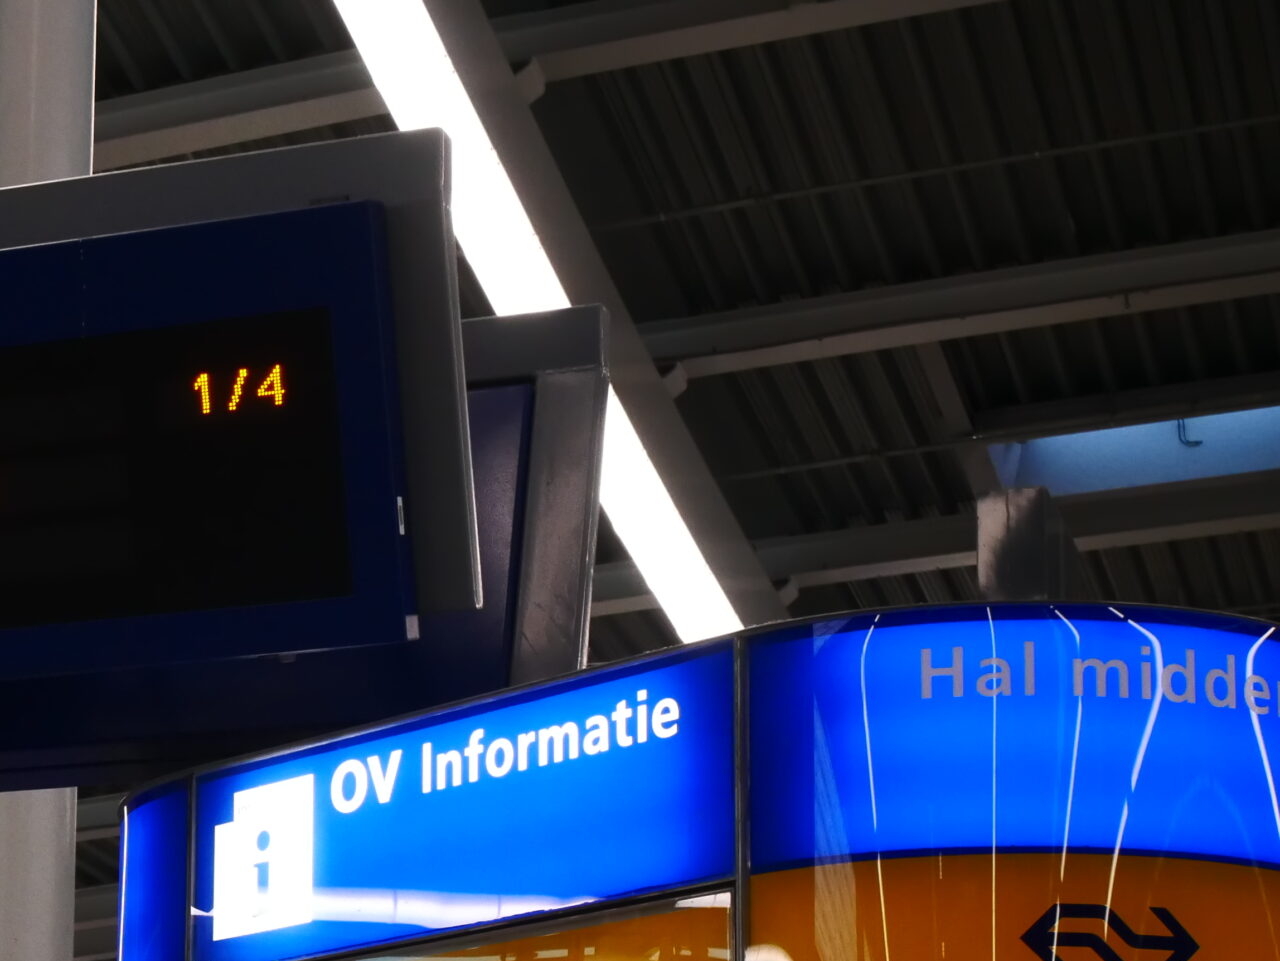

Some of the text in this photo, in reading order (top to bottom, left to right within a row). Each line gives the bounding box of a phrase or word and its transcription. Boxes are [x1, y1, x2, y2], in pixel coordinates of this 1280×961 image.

[193, 364, 286, 415] 1/4
[921, 640, 1280, 716] Hal midde
[329, 688, 681, 815] OV Informatie
